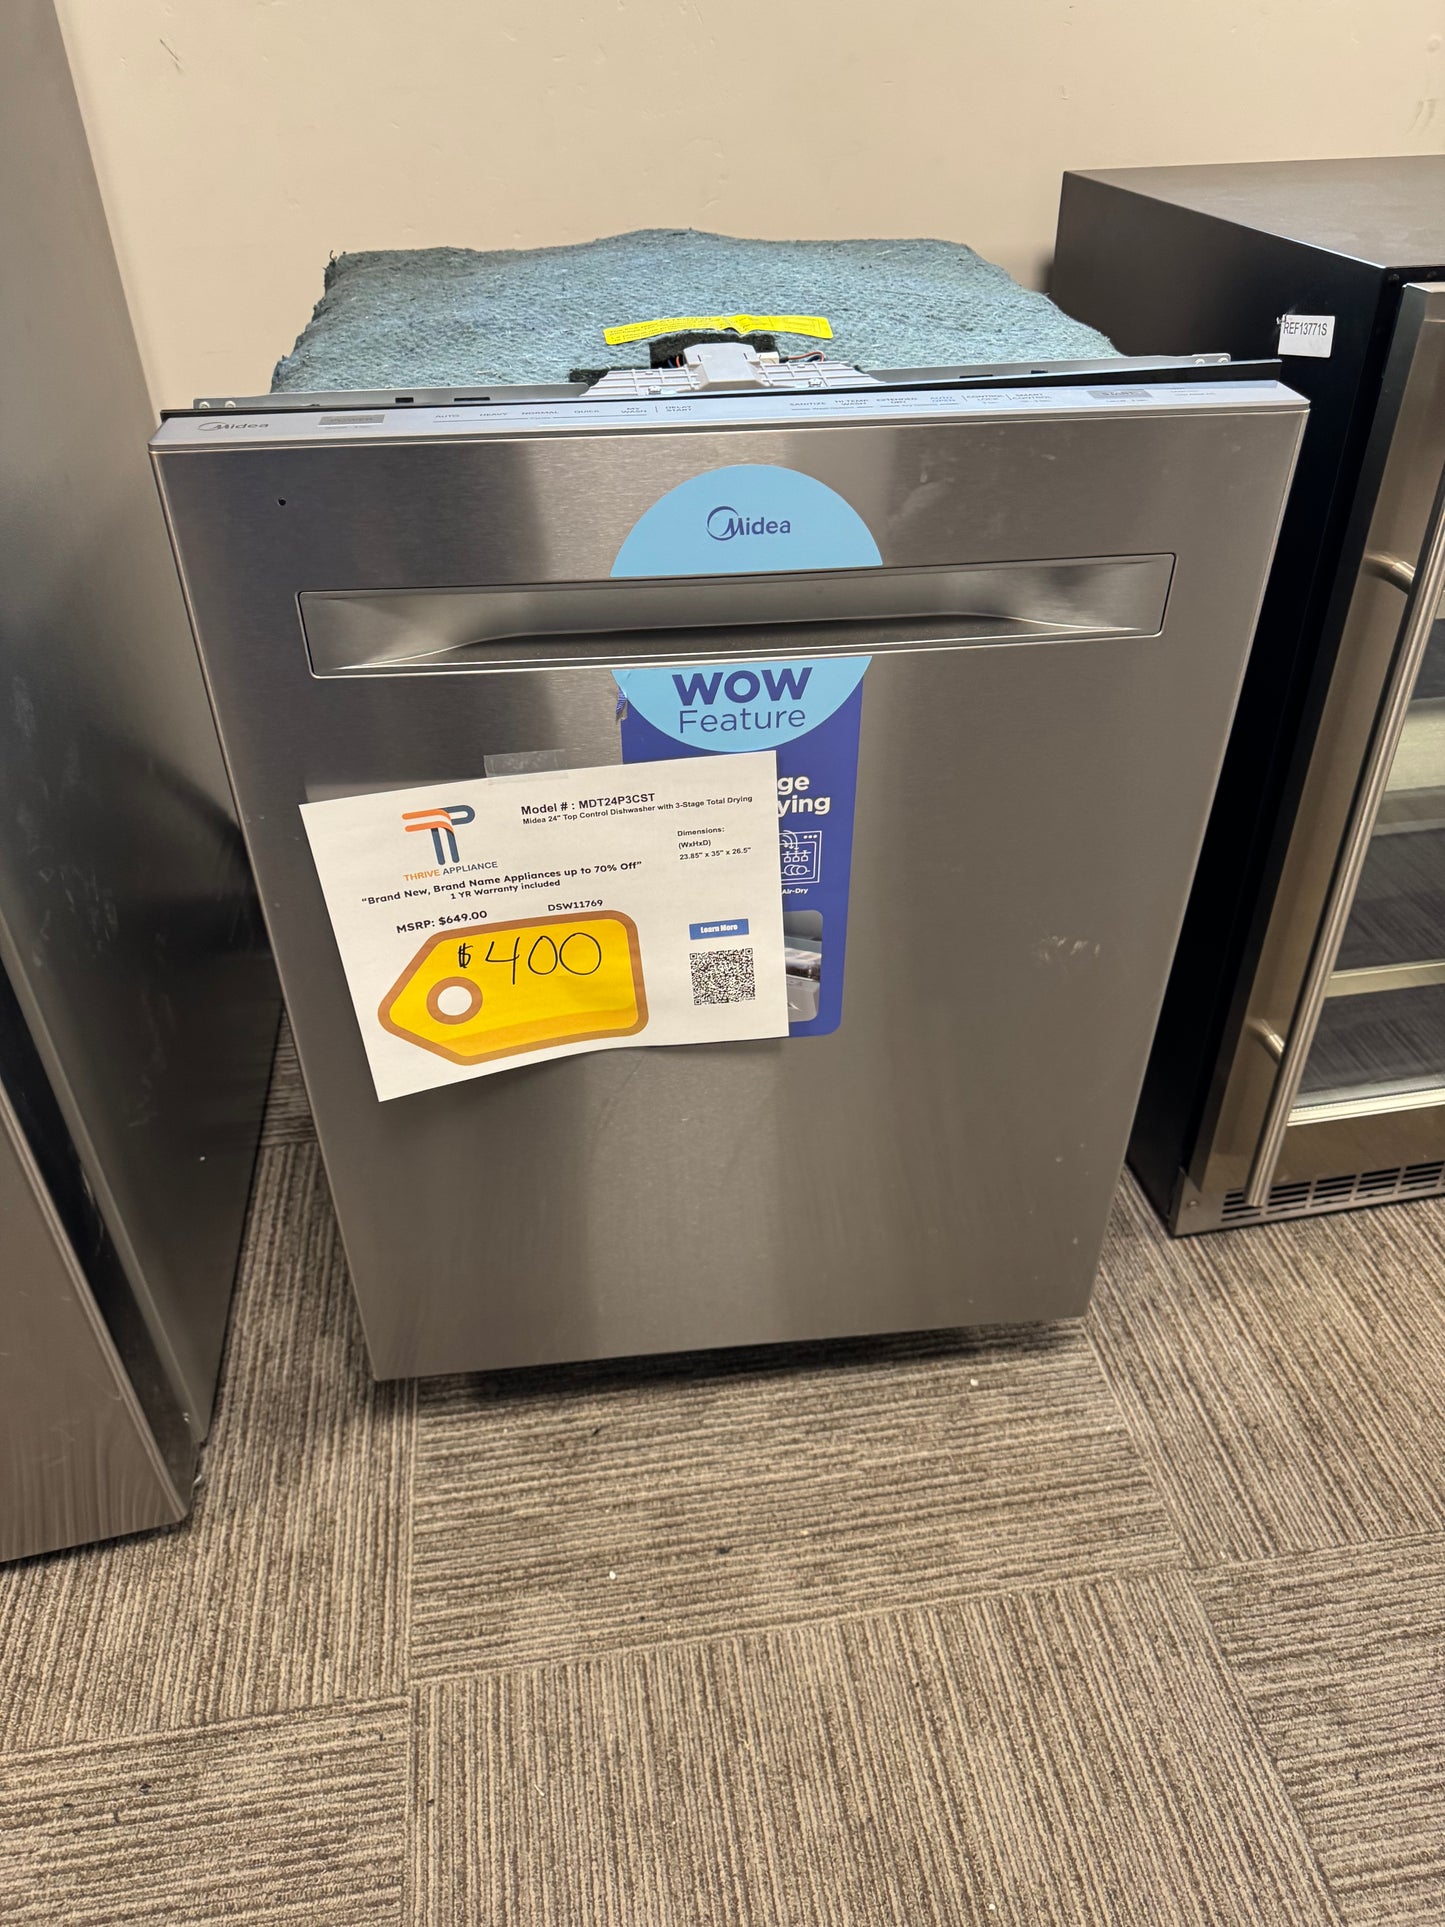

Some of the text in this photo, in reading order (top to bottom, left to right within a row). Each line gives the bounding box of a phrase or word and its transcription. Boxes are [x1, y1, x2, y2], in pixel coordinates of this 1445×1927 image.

[1284, 322, 1328, 336] REF13771S
[198, 421, 269, 431] Midea
[707, 506, 791, 541] Midea
[672, 667, 813, 706] WOW
[679, 708, 806, 733] Feature
[521, 803, 557, 815] Model
[560, 802, 568, 811] #
[578, 793, 656, 809] MDT24P3CST
[522, 796, 753, 825] Midea 24" Top Control Dishwasher with 3-Stage Total Drying
[777, 795, 831, 818] ying
[677, 827, 725, 837] Dimensions:
[678, 839, 712, 850] (WxHxD)
[711, 849, 724, 857] 35"
[403, 861, 498, 881] THRIVE APPLIANCE
[404, 888, 431, 899] New,
[433, 881, 466, 893] Brand
[469, 876, 501, 888] Name
[503, 869, 562, 883] Appliances
[564, 868, 578, 878] up
[580, 867, 592, 875] to
[594, 863, 618, 873] 70%
[458, 890, 472, 899] YR
[474, 884, 518, 897] Warranty
[521, 879, 561, 890] included
[547, 899, 604, 912] DSW11769
[396, 910, 488, 934] MSRP: $649.00
[700, 924, 739, 934] Learn More
[457, 931, 602, 985] $400
